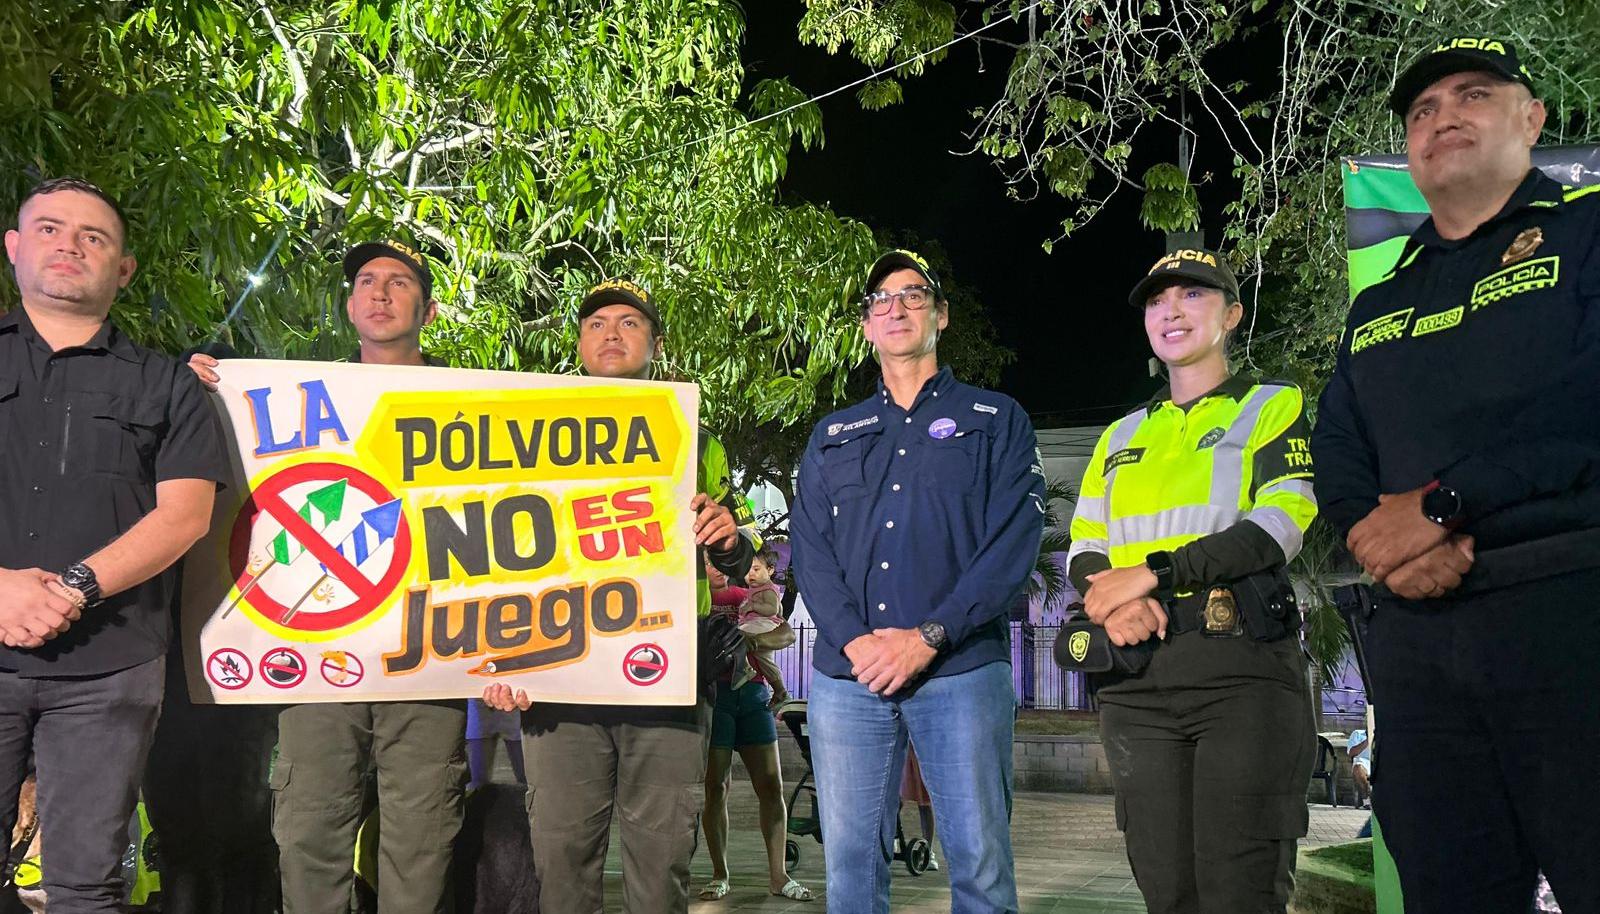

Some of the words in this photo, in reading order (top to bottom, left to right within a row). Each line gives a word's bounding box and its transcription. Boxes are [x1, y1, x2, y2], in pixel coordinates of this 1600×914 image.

[243, 379, 350, 459] LA
[395, 410, 661, 482] PÓLVORA
[422, 494, 557, 582] NO
[571, 486, 655, 530] ES
[577, 521, 665, 562] UN
